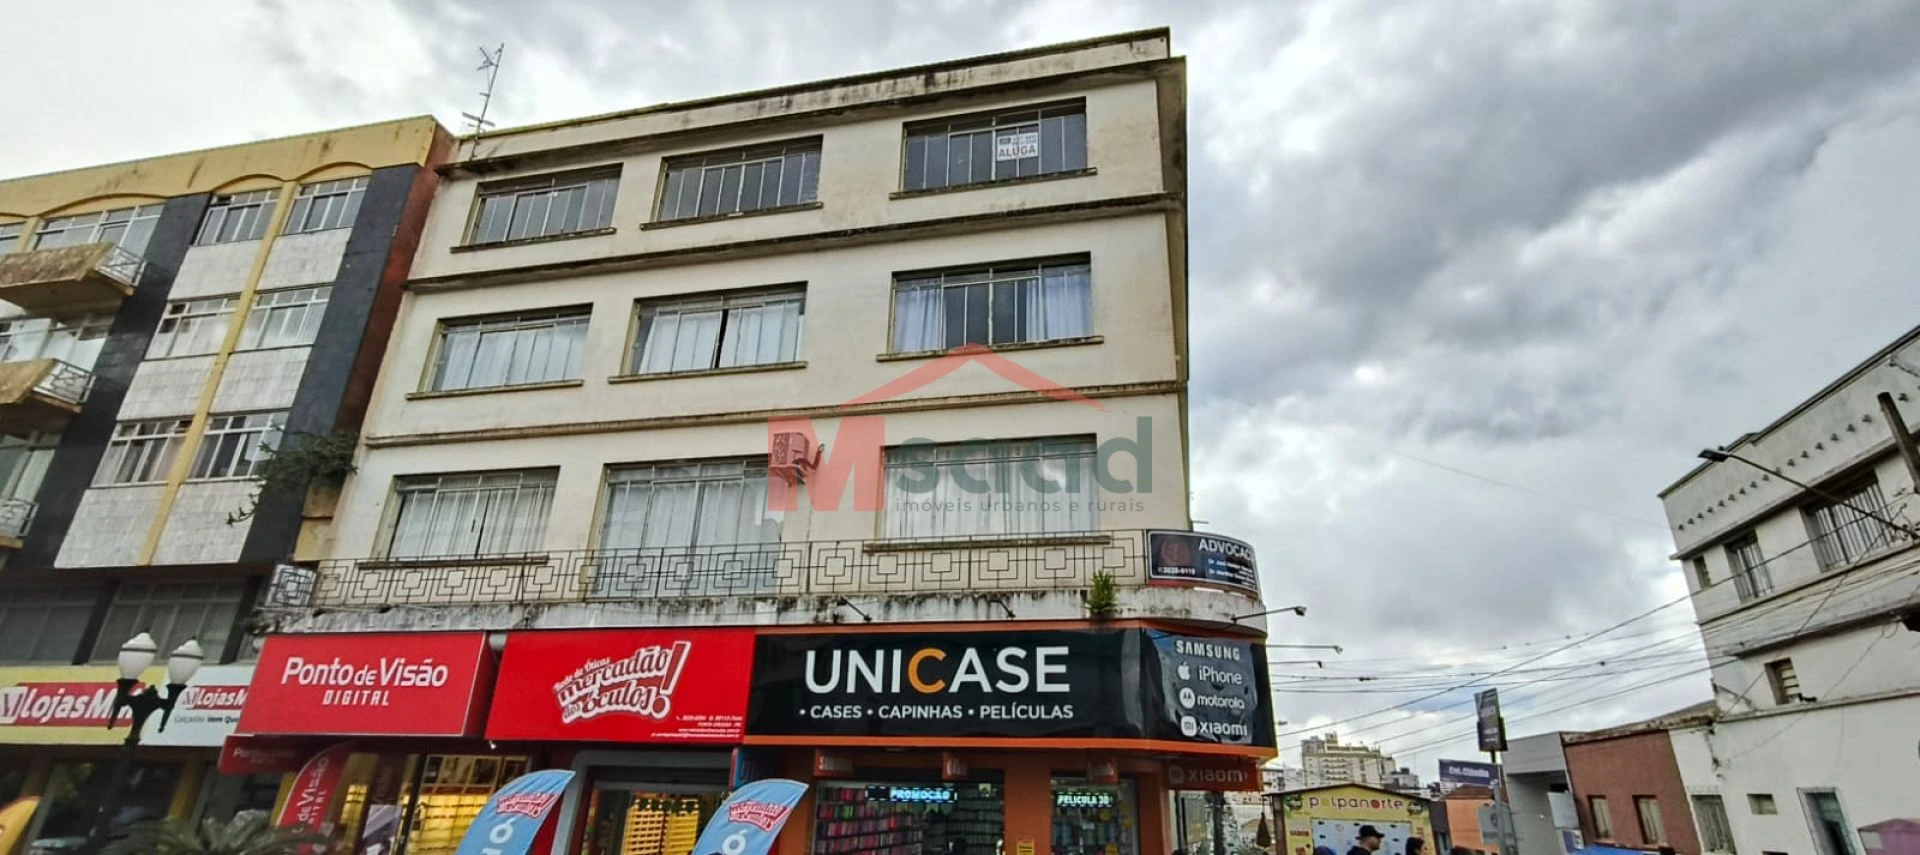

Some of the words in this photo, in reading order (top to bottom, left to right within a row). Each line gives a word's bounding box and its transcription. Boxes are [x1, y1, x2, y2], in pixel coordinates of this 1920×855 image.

[998, 145, 1036, 157] ALUGA
[1175, 639, 1240, 660] SAMSUNG
[281, 656, 353, 686] Ponto
[354, 664, 377, 686] de
[379, 657, 449, 687] Visão
[805, 646, 1071, 694] UNICASE
[1198, 665, 1242, 685] iPhone
[322, 690, 390, 706] DIGITAL
[1197, 694, 1245, 709] motorola
[810, 704, 862, 719] CASES
[878, 704, 963, 719] CAPINHAS
[979, 701, 1074, 719] PELÍCULAS
[1199, 721, 1248, 736] xiaomi
[1188, 769, 1248, 783] xiaomi
